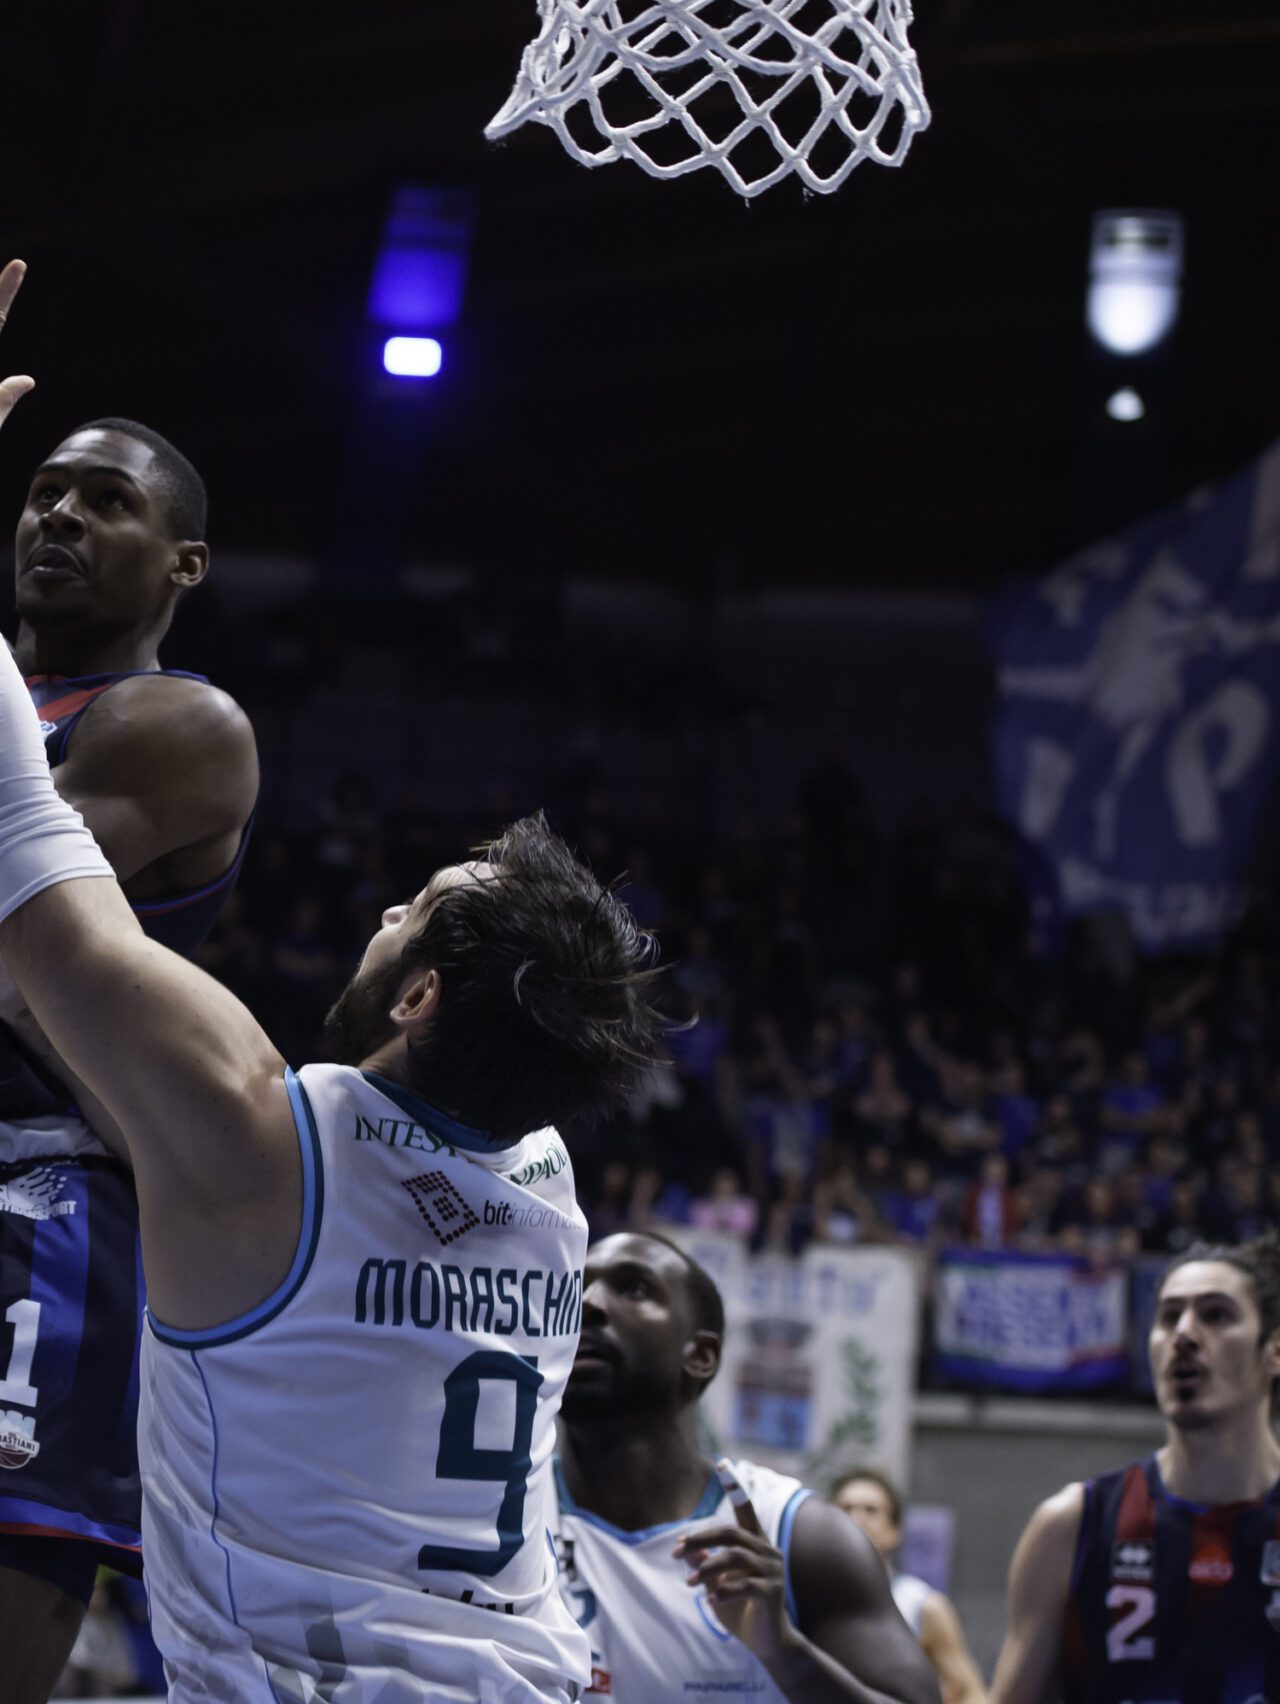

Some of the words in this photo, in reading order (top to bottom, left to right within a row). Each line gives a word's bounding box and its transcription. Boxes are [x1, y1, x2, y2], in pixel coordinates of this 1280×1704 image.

[354, 1258, 582, 1337] MORASCHIN
[418, 1350, 544, 1577] 9
[1106, 1586, 1155, 1663] 2
